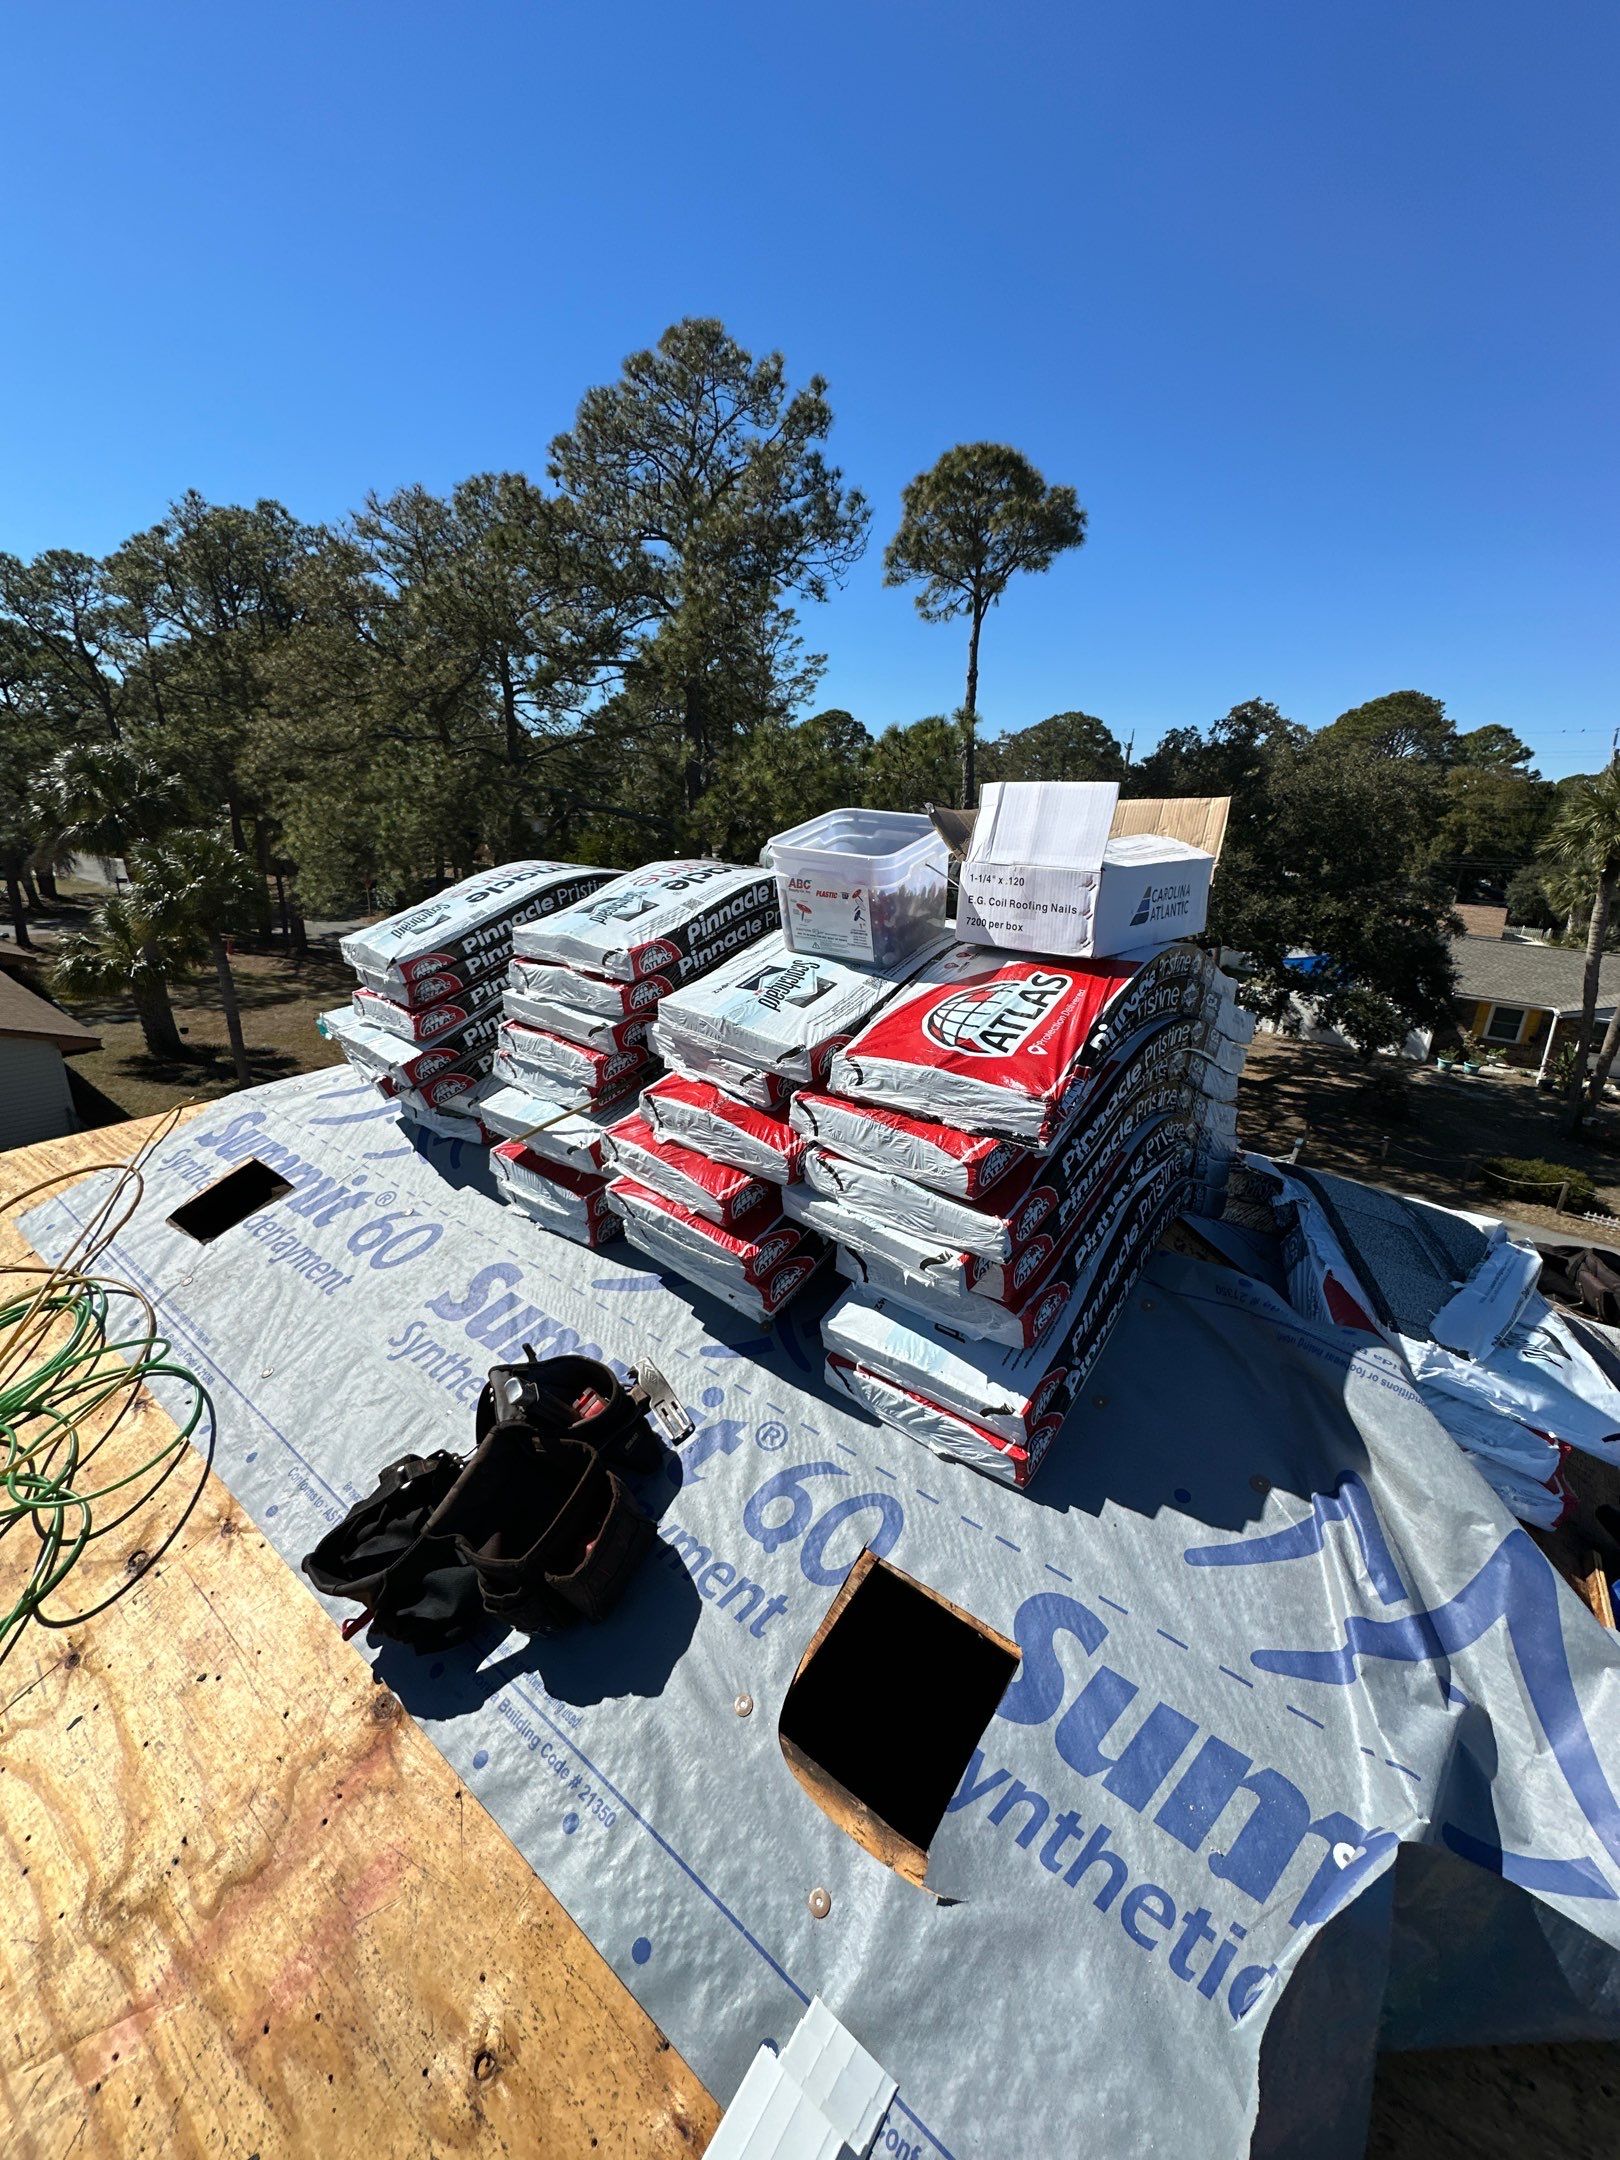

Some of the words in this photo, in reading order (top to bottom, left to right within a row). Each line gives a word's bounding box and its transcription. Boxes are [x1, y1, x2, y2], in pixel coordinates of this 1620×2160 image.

[788, 877, 812, 890] ABC
[998, 876, 1003, 885] x
[1005, 876, 1025, 887] .120
[1151, 884, 1191, 902] CAROLINA
[816, 889, 838, 899] PLASTIC
[968, 894, 987, 906] E.G.
[989, 897, 1007, 909] Coil
[1009, 899, 1048, 914] Roofing
[1050, 902, 1078, 915] Nails
[687, 884, 769, 945] Pinnacle
[1149, 901, 1189, 921] ATLANTIC
[462, 896, 555, 955] Pinnacle
[966, 916, 987, 928] 7200
[988, 920, 1003, 931] per
[1005, 921, 1024, 932] box
[678, 917, 762, 978] Pinnacle
[644, 953, 673, 974] ATLAS
[634, 987, 664, 1009] ATLAS
[425, 1012, 456, 1034] ATLAS
[979, 973, 1068, 1054] ATLAS
[1036, 1014, 1066, 1048] Protection
[1061, 987, 1086, 1019] Delivered
[422, 1055, 452, 1079] ATLAS
[608, 1052, 638, 1080] ATLAS
[438, 1082, 467, 1104] ATLAS
[736, 1186, 769, 1216] ATLAS
[347, 1208, 444, 1270] 60
[242, 1212, 355, 1297] derlayment
[1367, 1371, 1379, 1384] or
[288, 1466, 318, 1502] Conforms
[313, 1495, 324, 1508] to
[743, 1461, 904, 1587] 60
[561, 1706, 583, 1731] used!
[498, 1697, 541, 1753] Building
[540, 1740, 572, 1781] Code
[568, 1776, 583, 1791] #
[577, 1783, 618, 1830] 21350
